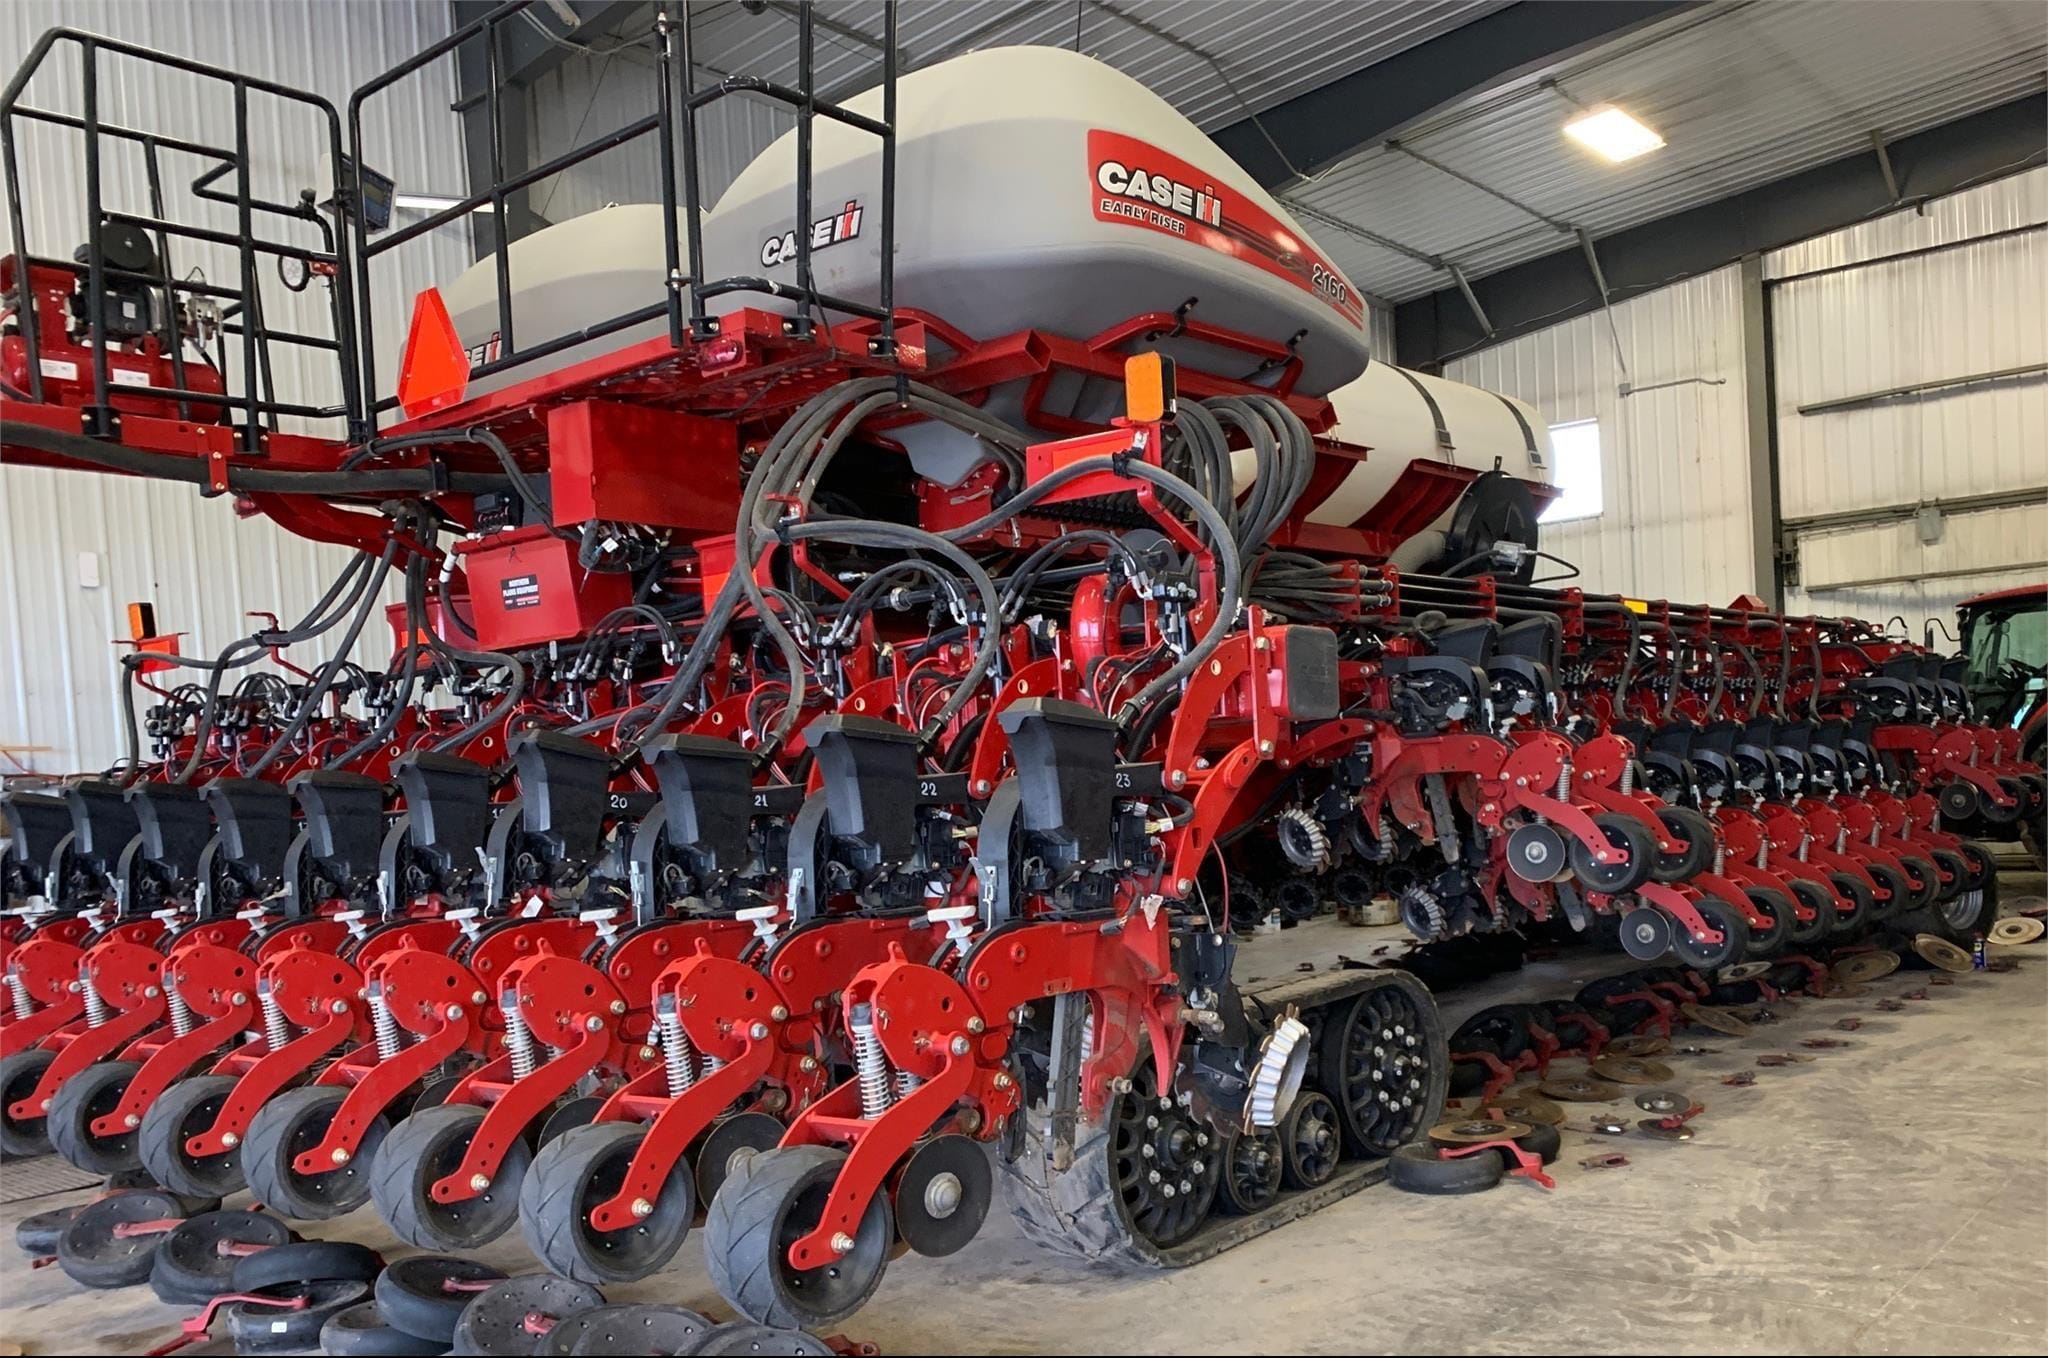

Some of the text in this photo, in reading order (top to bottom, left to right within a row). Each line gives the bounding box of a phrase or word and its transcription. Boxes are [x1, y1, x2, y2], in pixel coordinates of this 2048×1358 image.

[1097, 160, 1194, 216] CASE
[1100, 198, 1186, 235] EARLY RISER
[761, 217, 834, 267] CAE
[1312, 263, 1347, 305] 2160
[920, 781, 938, 796] 22
[1115, 772, 1131, 788] 23
[610, 794, 628, 809] 20
[753, 794, 769, 807] 21
